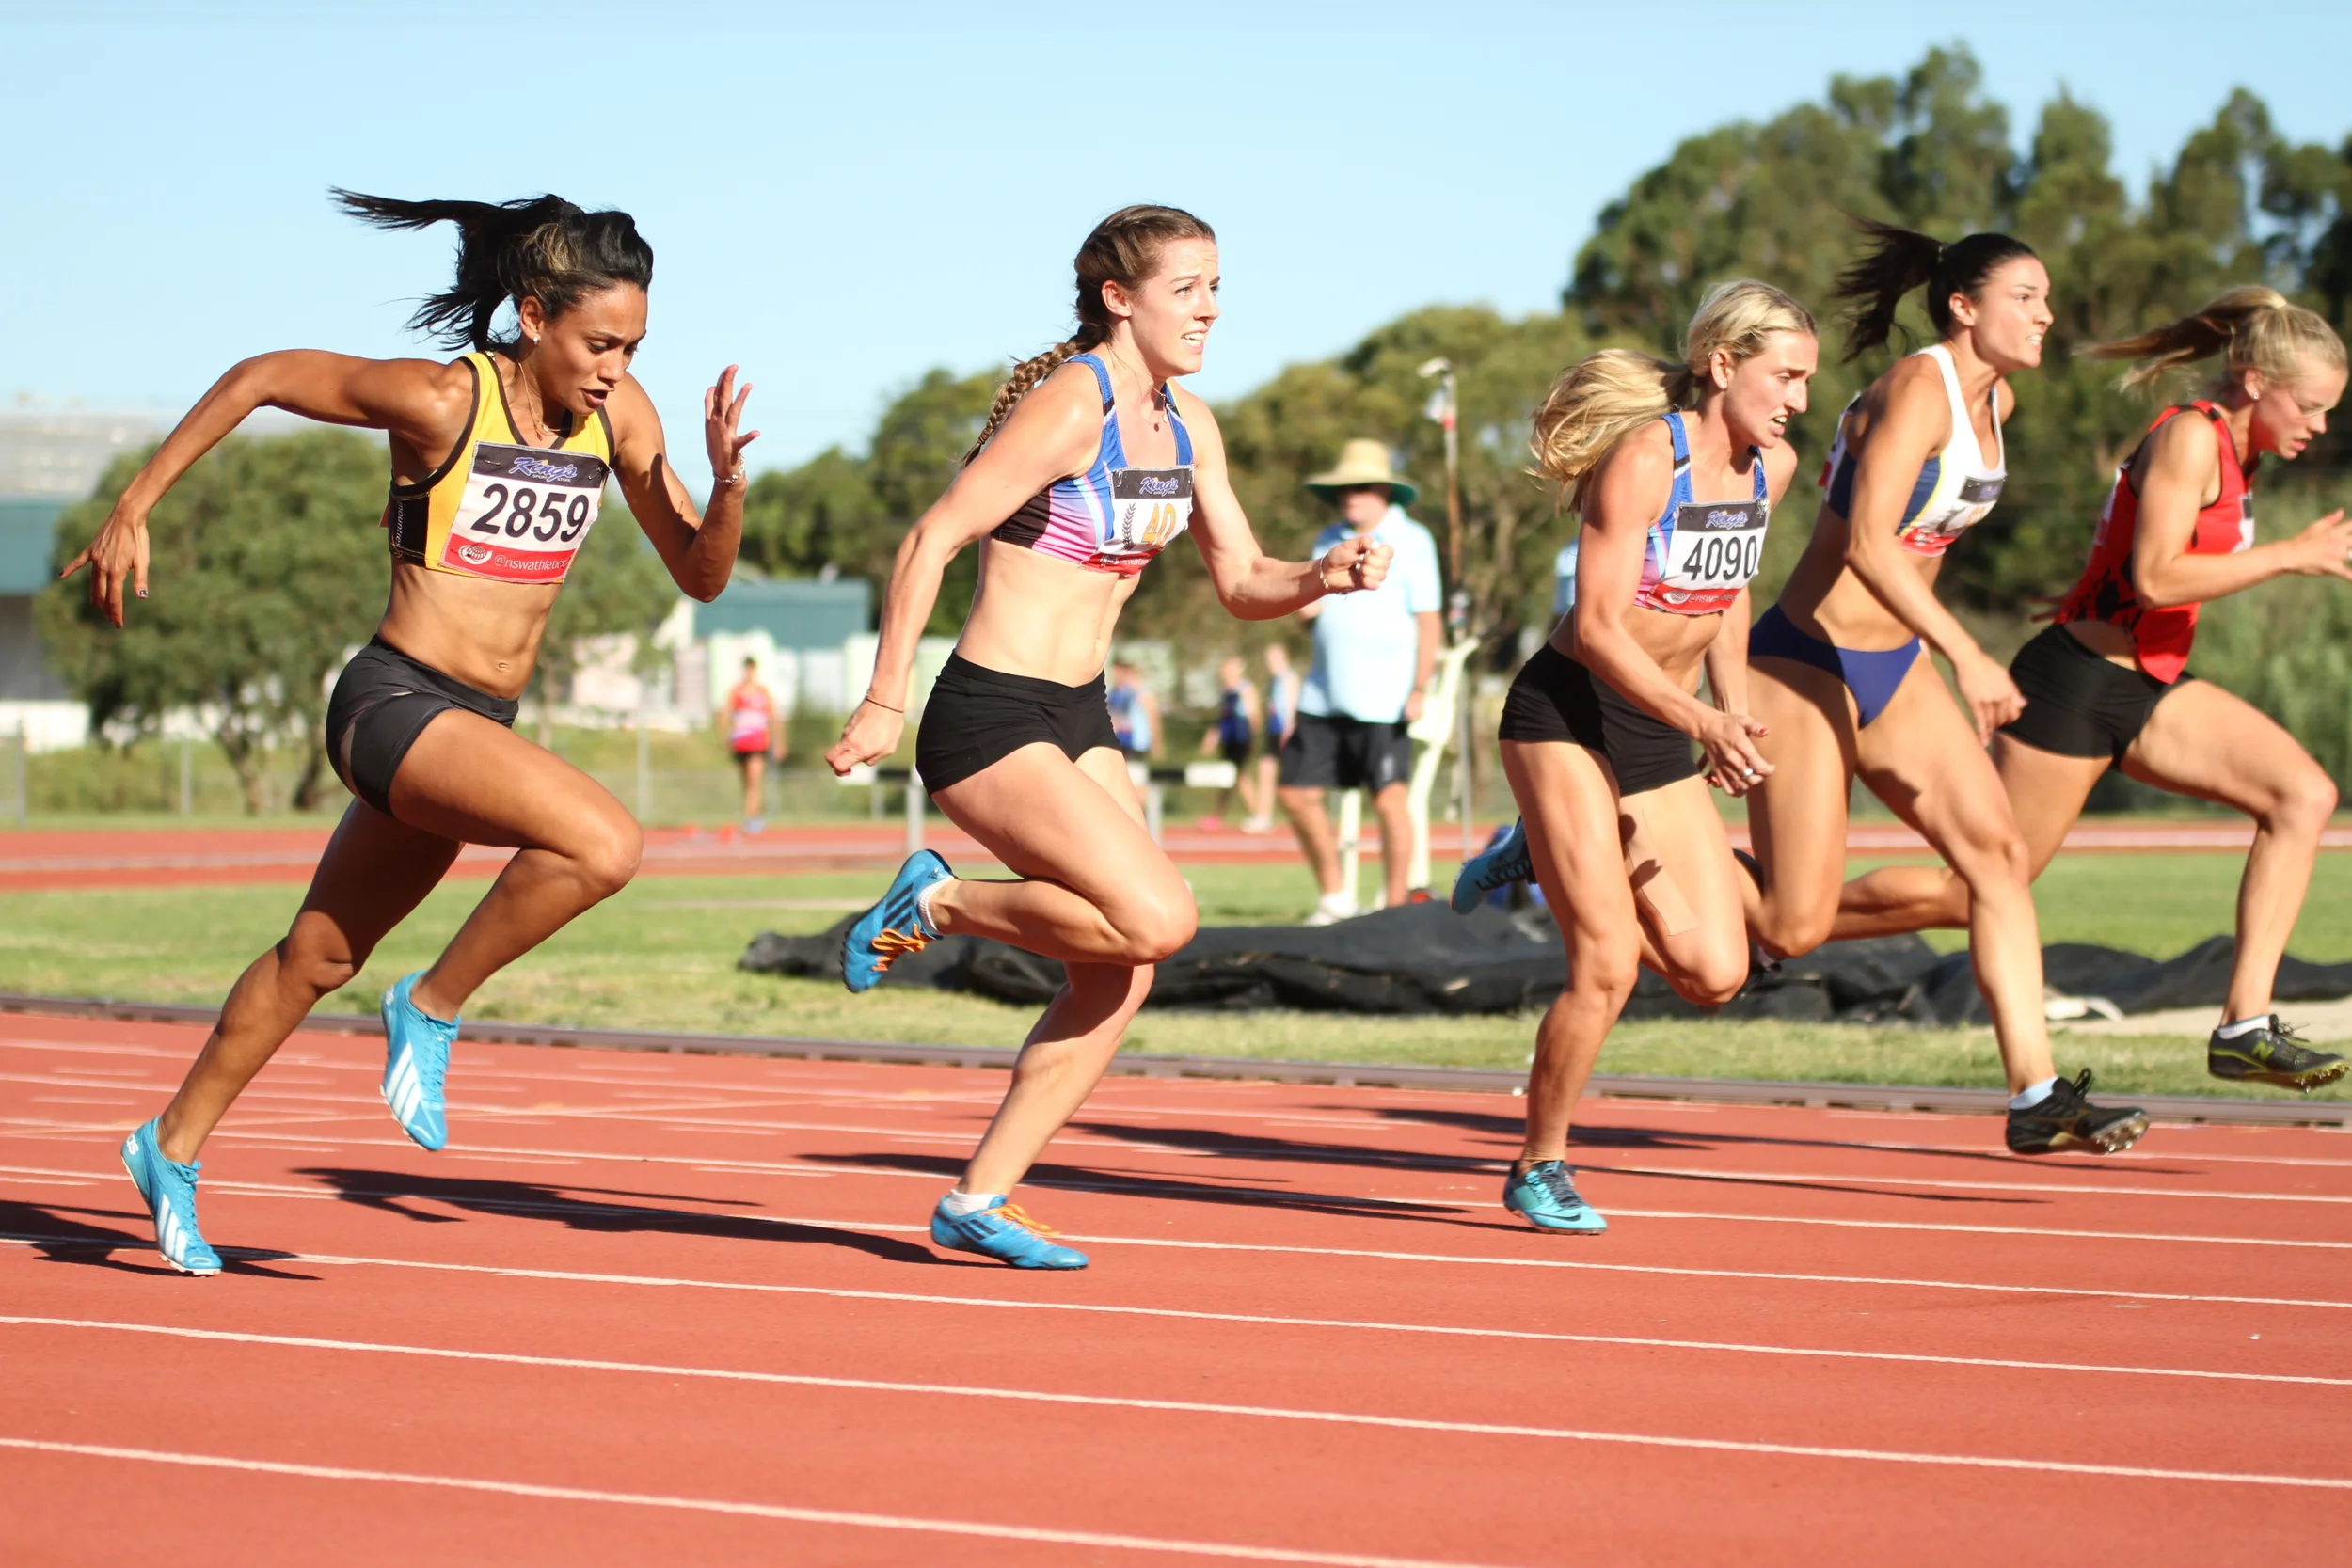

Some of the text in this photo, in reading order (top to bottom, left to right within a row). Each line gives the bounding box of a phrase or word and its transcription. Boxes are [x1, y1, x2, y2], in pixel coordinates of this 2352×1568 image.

[509, 457, 578, 483] King's
[1139, 476, 1179, 497] King's
[470, 483, 590, 543] 2859
[1141, 503, 1176, 546] 40
[1705, 509, 1748, 530] King's
[1682, 535, 1757, 581] 4090
